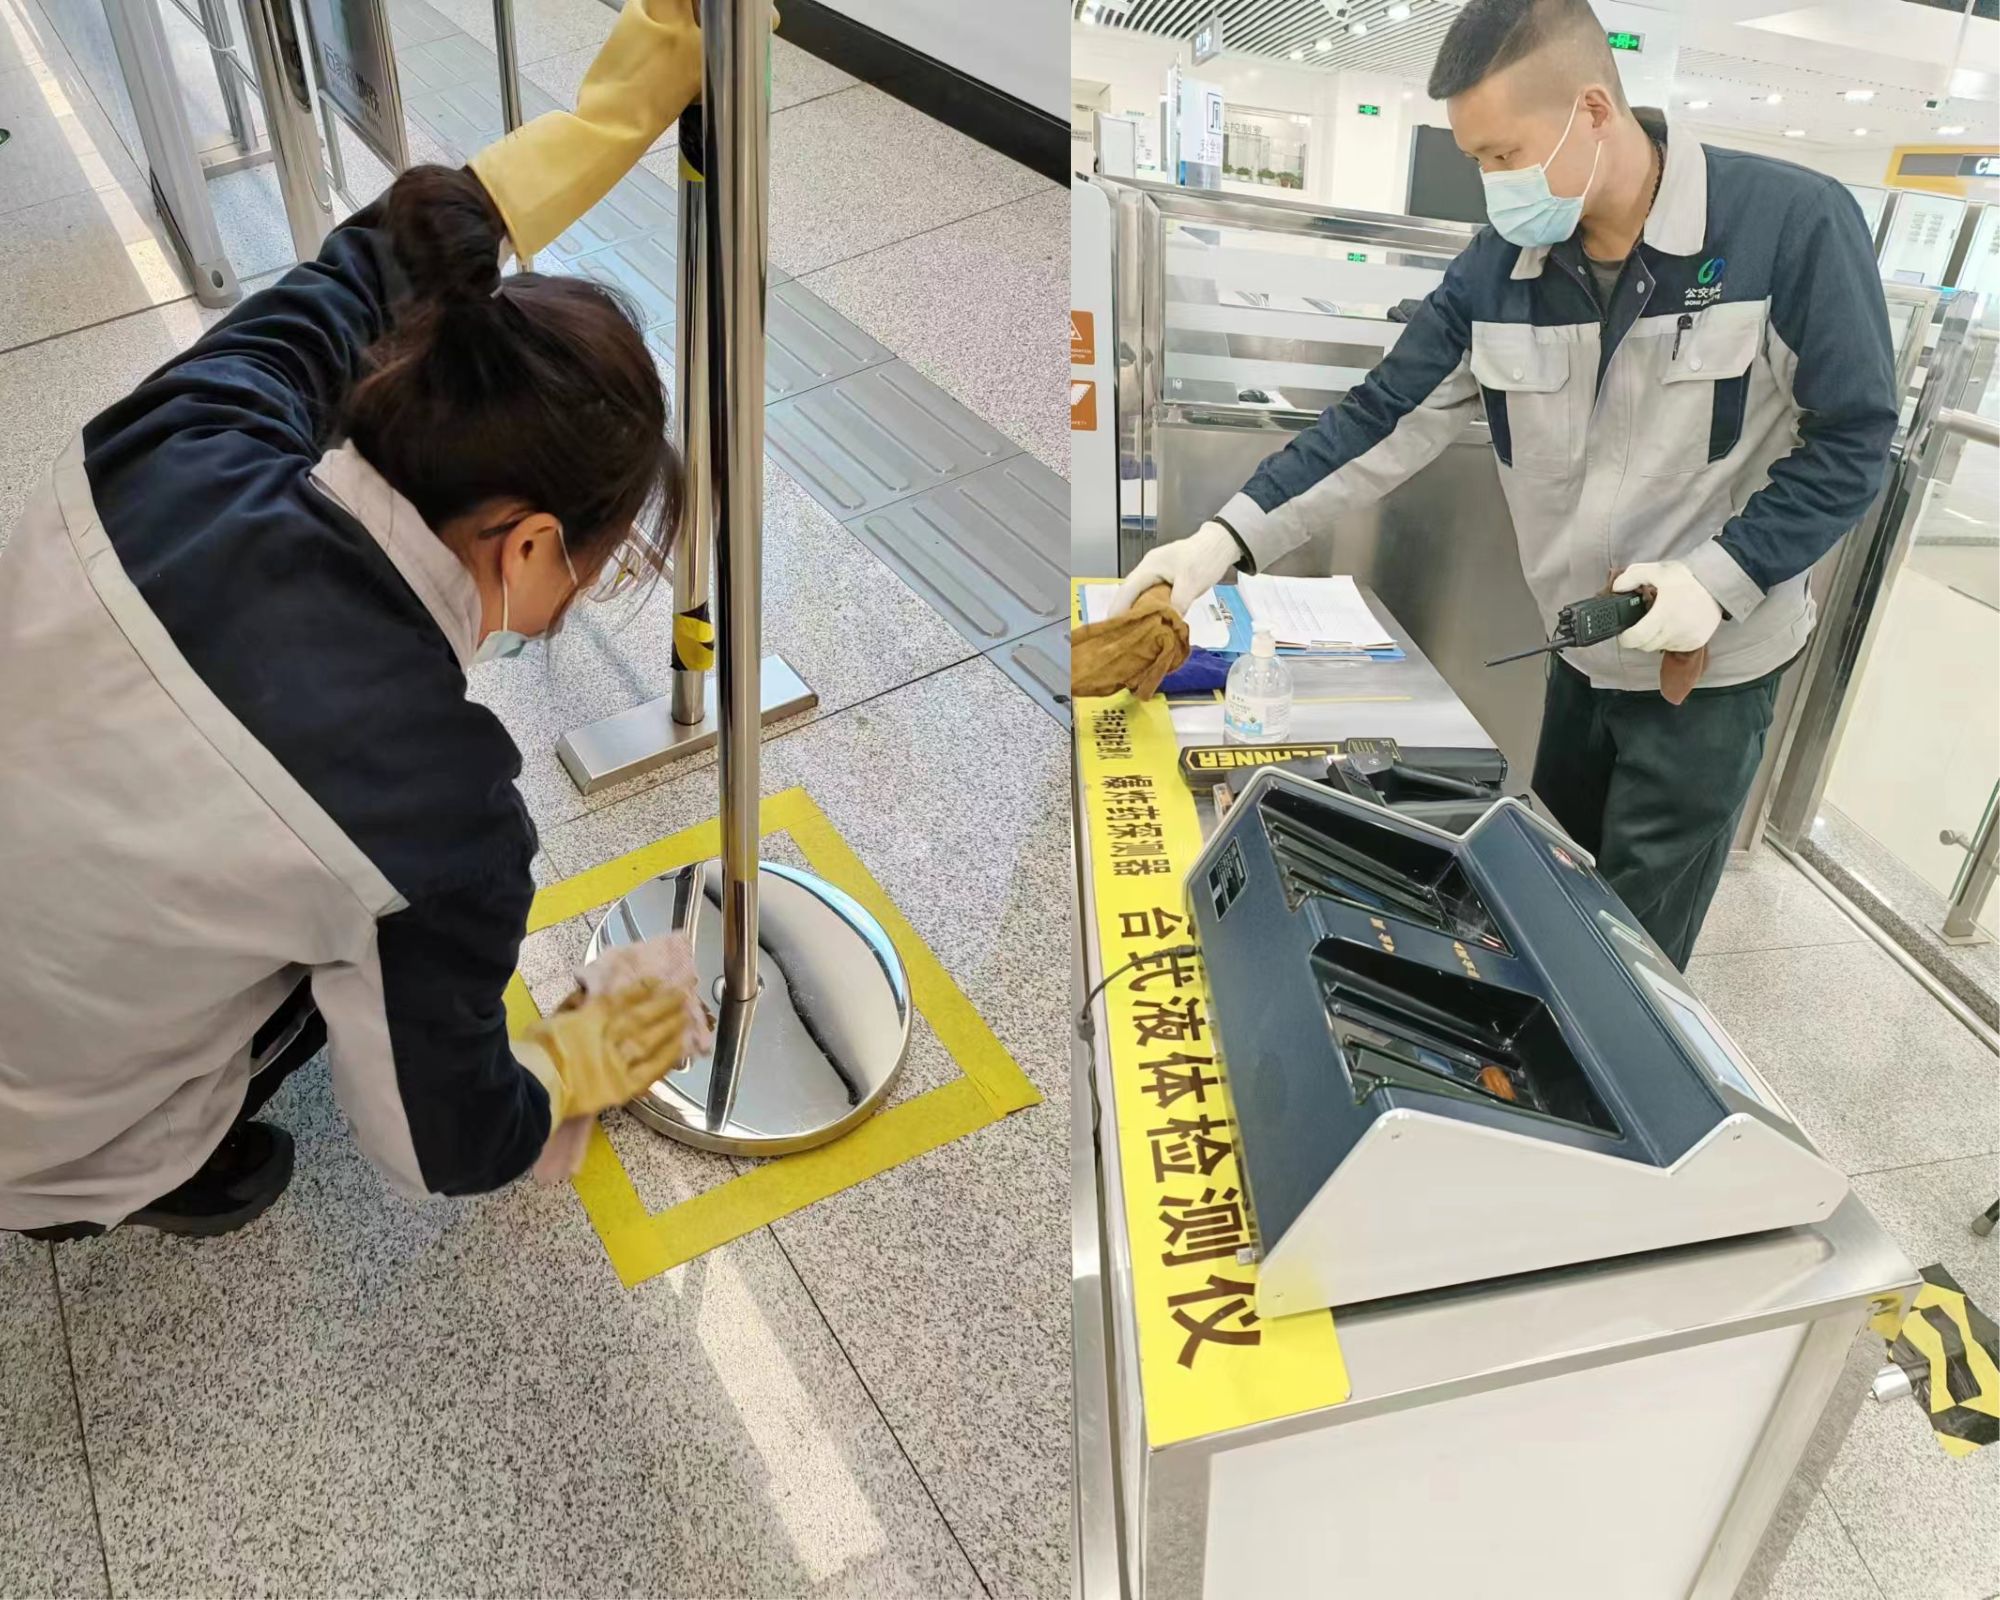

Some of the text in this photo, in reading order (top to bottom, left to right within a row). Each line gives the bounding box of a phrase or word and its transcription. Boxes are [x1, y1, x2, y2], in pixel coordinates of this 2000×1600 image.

[1198, 750, 1327, 768] ANNER
[1101, 775, 1172, 876] 爆炸药探测器
[1118, 905, 1262, 1370] 台式液体检测仪
